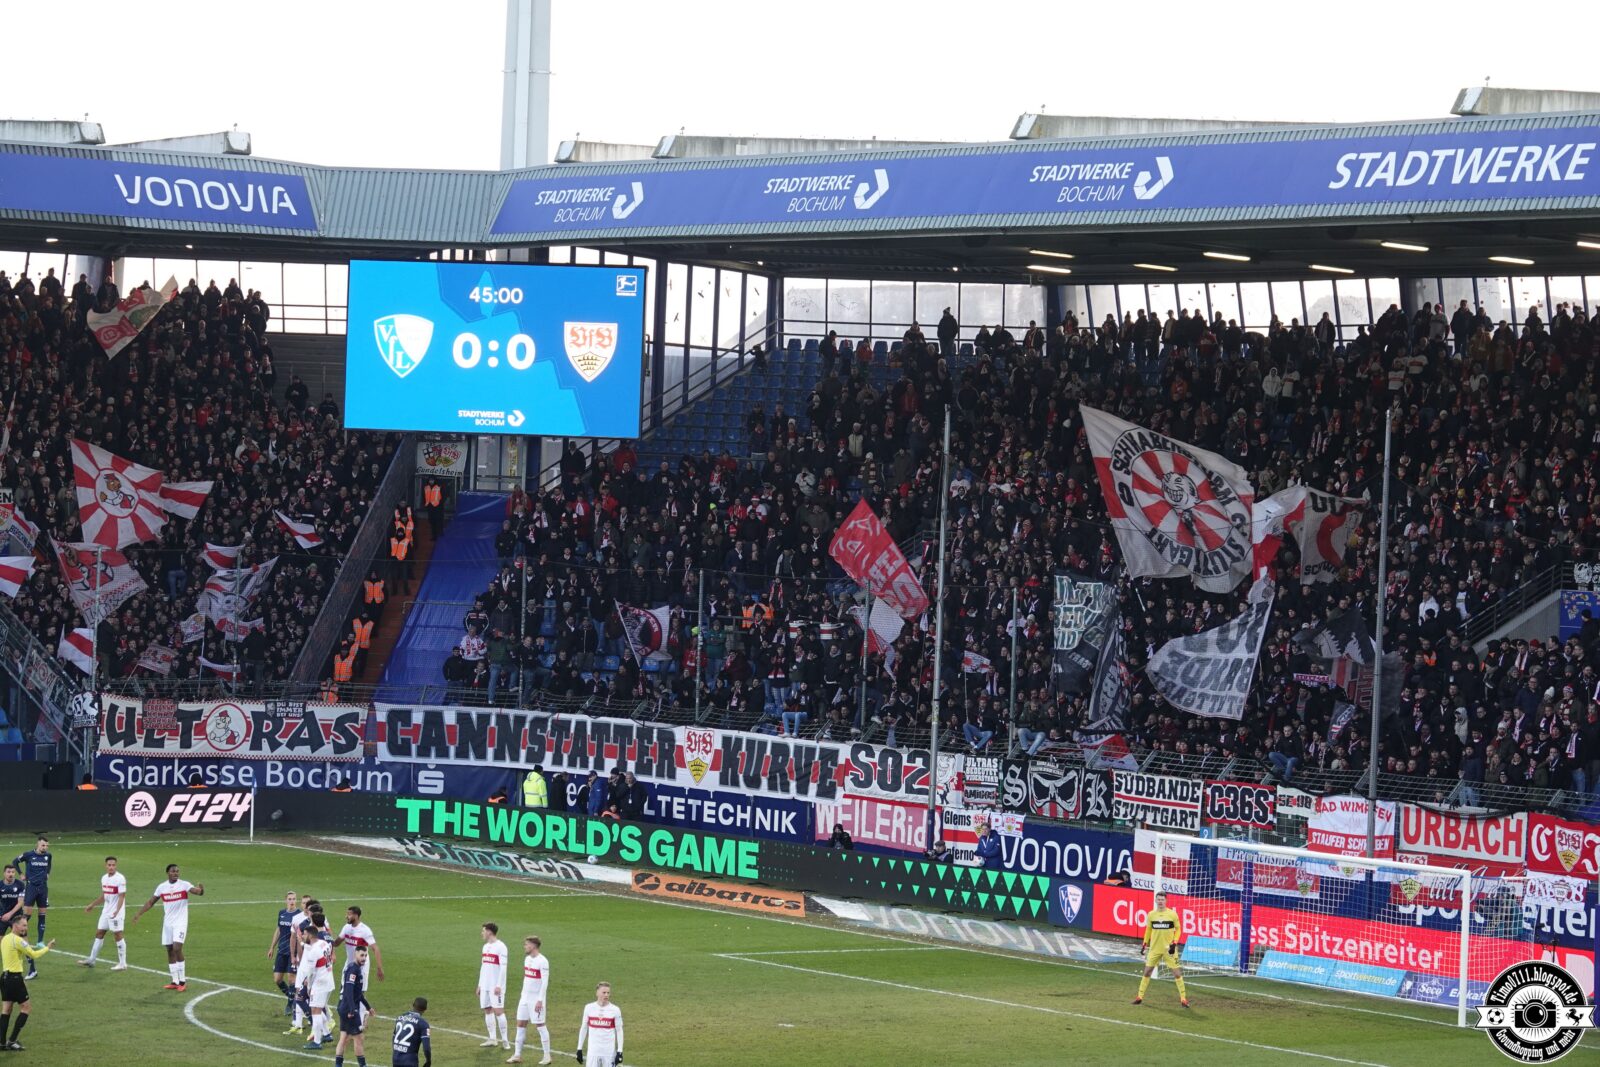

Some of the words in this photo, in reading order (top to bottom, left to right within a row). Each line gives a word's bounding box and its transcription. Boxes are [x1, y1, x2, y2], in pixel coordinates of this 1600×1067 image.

[1029, 161, 1134, 183] STADTWERKE
[1328, 143, 1597, 189] STADTWERKE
[764, 174, 855, 194] STADTWERKE
[1057, 185, 1124, 202] BOCHUM
[534, 186, 616, 205] STADTWERKE
[787, 195, 846, 213] BOCHUM
[554, 207, 606, 223] BOCHUM
[469, 286, 524, 305] 45:00
[458, 409, 505, 419] STADTWERKE
[474, 418, 505, 427] BOCHUM
[105, 701, 360, 755] ULTRAS
[386, 709, 676, 781] CANNSTATTER
[719, 735, 840, 800] KURVE
[966, 757, 998, 769] ULTRAS
[109, 758, 253, 790] Sparkasse
[266, 761, 392, 793] Bochum
[1115, 772, 1200, 804] SÜDBANDE
[131, 799, 150, 811] EA
[1114, 801, 1199, 829] STUTTGART
[1208, 784, 1271, 826] C36S
[944, 810, 972, 827] Glems
[396, 798, 481, 838] THE
[649, 829, 759, 880] GAME
[1312, 831, 1346, 849] STAUFER
[1403, 805, 1523, 858] URBACH
[946, 846, 974, 861] nferno
[665, 877, 802, 911] albatros
[1182, 908, 1279, 947] Business
[1285, 922, 1443, 970] Spitzenreiter
[393, 1021, 415, 1047] 22
